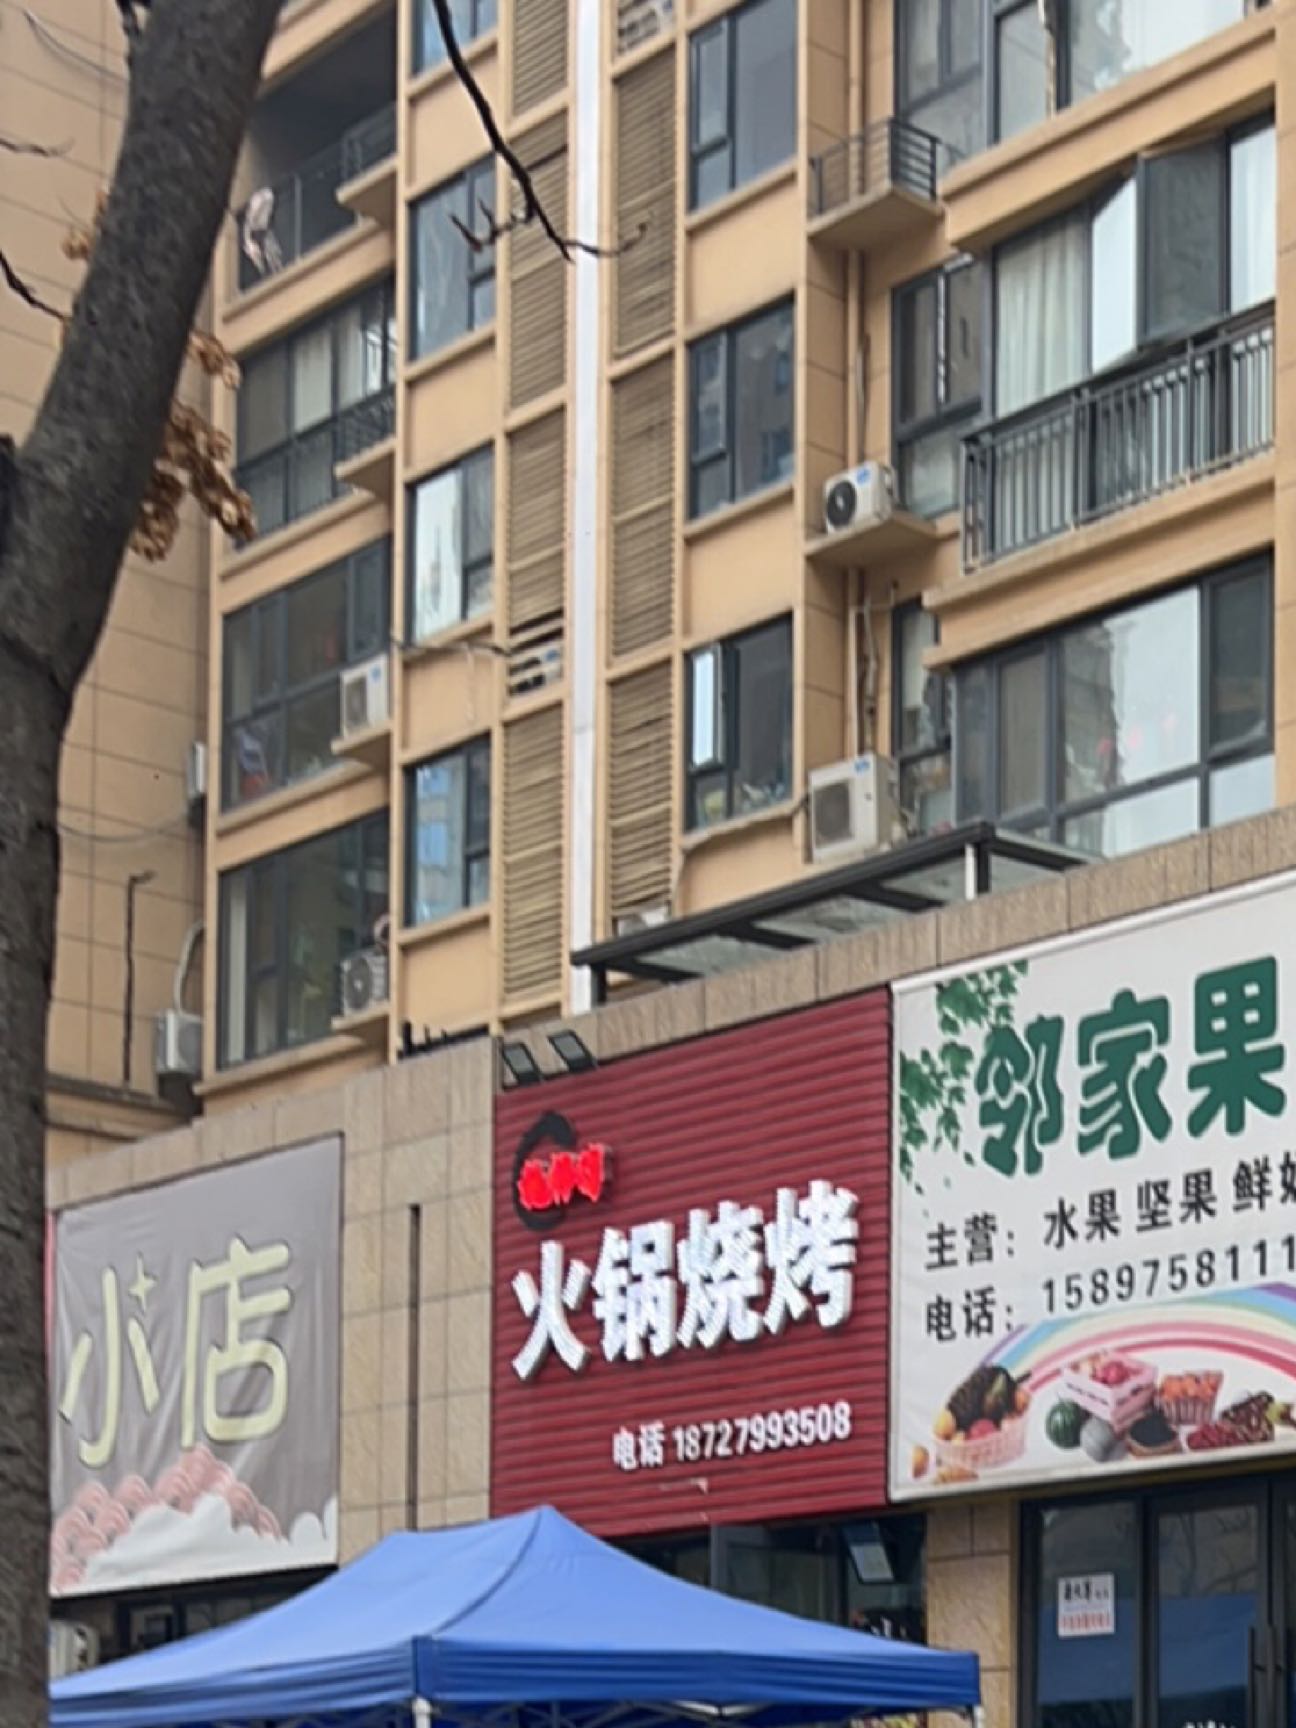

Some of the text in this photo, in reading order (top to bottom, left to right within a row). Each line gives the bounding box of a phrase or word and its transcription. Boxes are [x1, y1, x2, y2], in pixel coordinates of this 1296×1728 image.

[1042, 1186, 1123, 1249] 水果
[1135, 1165, 1219, 1233] 坚果
[58, 1235, 293, 1469] 小店
[510, 1178, 860, 1382] 火锅烧烤
[611, 1399, 853, 1472] 电话 18727993508
